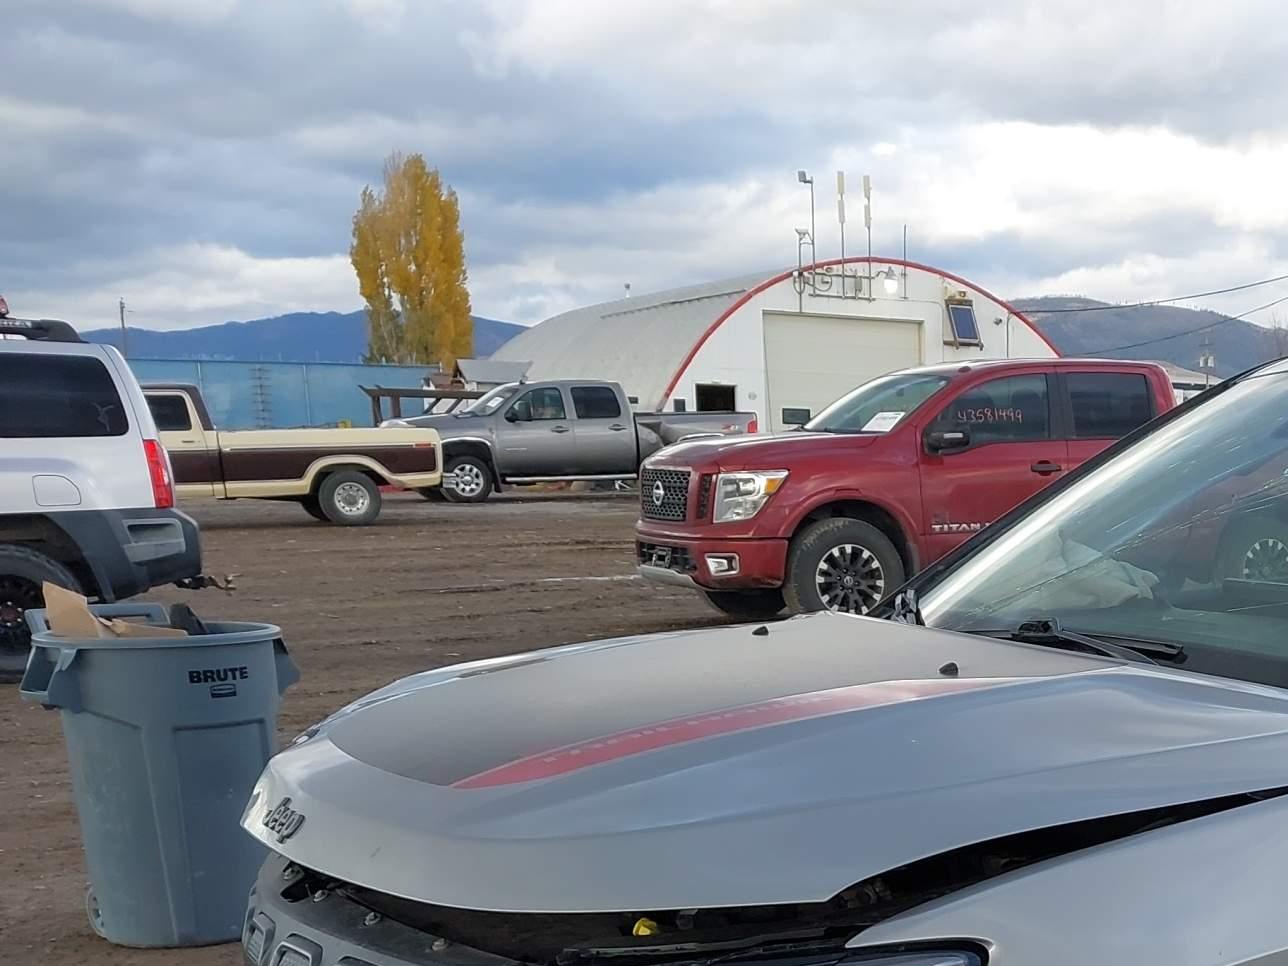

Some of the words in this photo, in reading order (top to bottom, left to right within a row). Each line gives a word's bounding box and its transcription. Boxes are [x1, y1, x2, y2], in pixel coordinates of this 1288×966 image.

[931, 522, 981, 532] TITAN
[188, 666, 249, 684] BRUTE
[263, 797, 305, 844] Jeep
